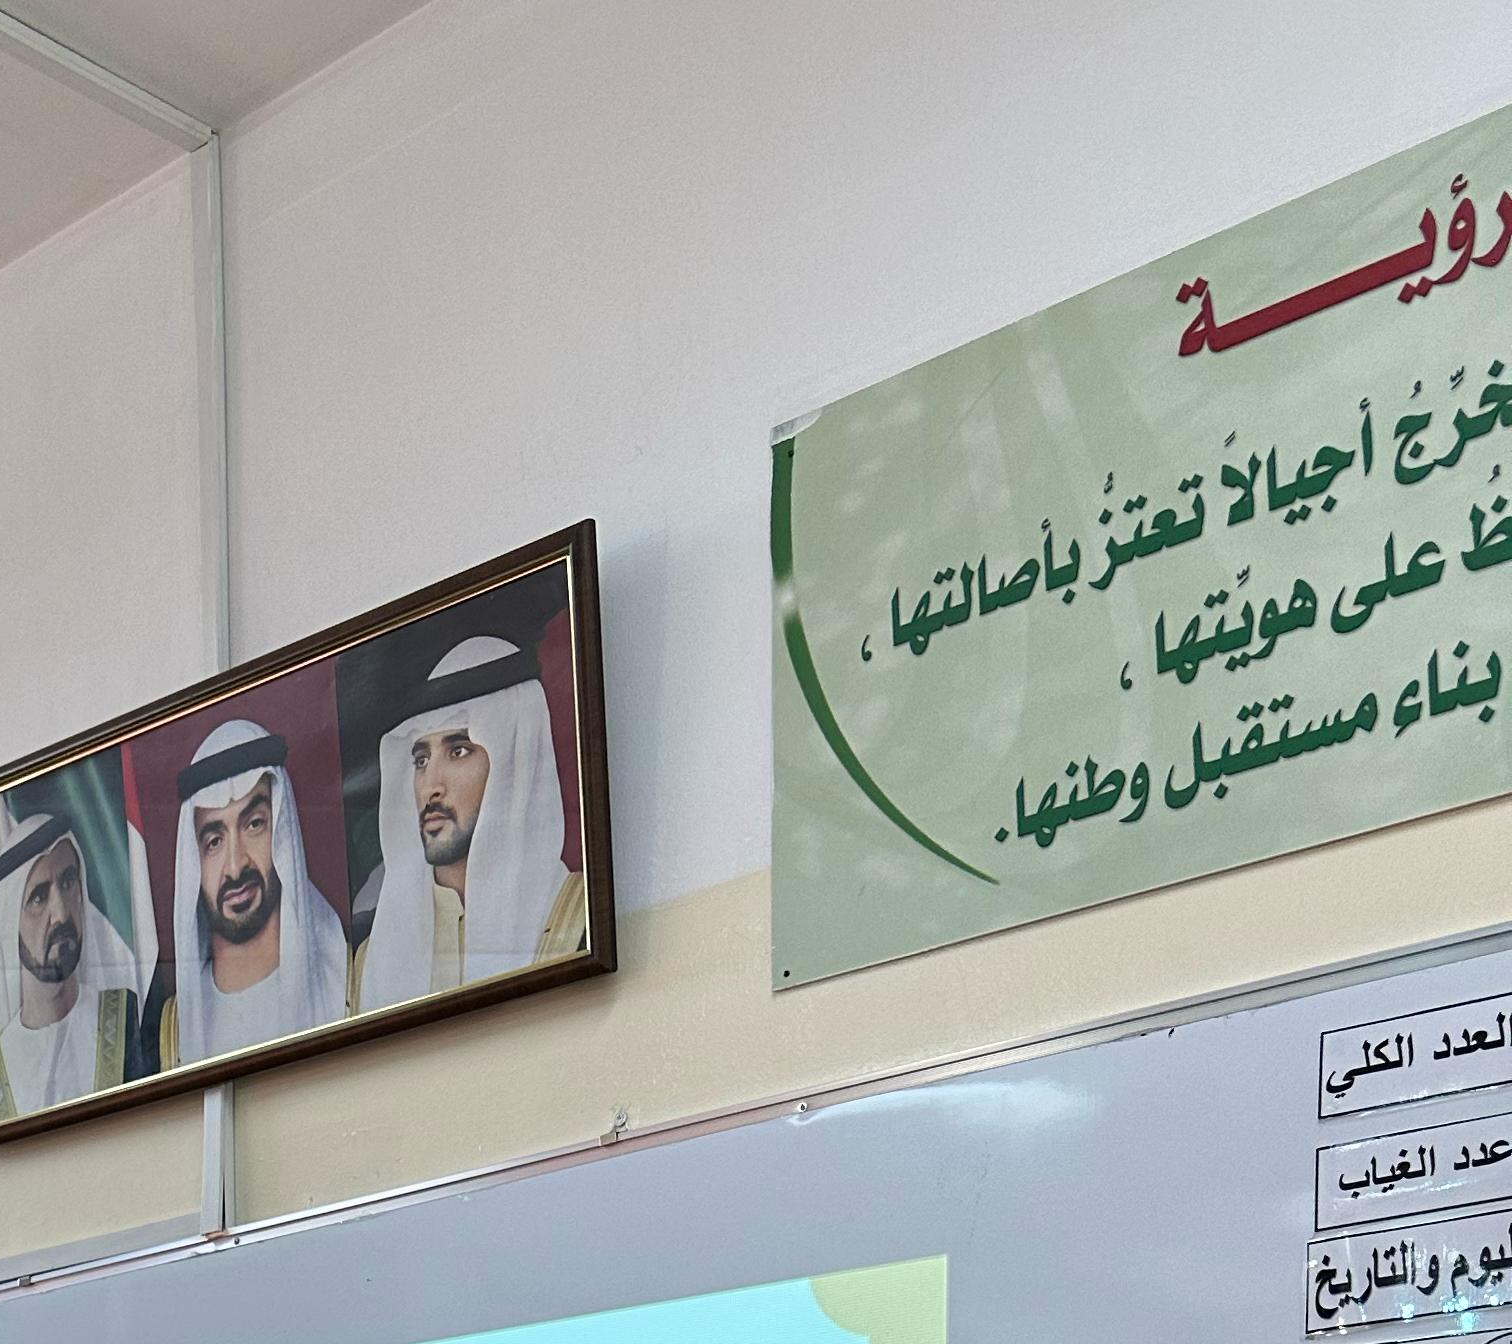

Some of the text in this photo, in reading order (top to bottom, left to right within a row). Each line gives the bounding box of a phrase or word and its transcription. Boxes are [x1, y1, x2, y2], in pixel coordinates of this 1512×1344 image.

[1331, 531, 1445, 634] على
[1164, 693, 1377, 808] مستقبل
[994, 754, 1150, 848] وطنها.
[1325, 1032, 1414, 1099] الكلي
[1338, 1139, 1512, 1199] عدد الغياب
[1315, 1222, 1512, 1320] ليوم والتاريخ
